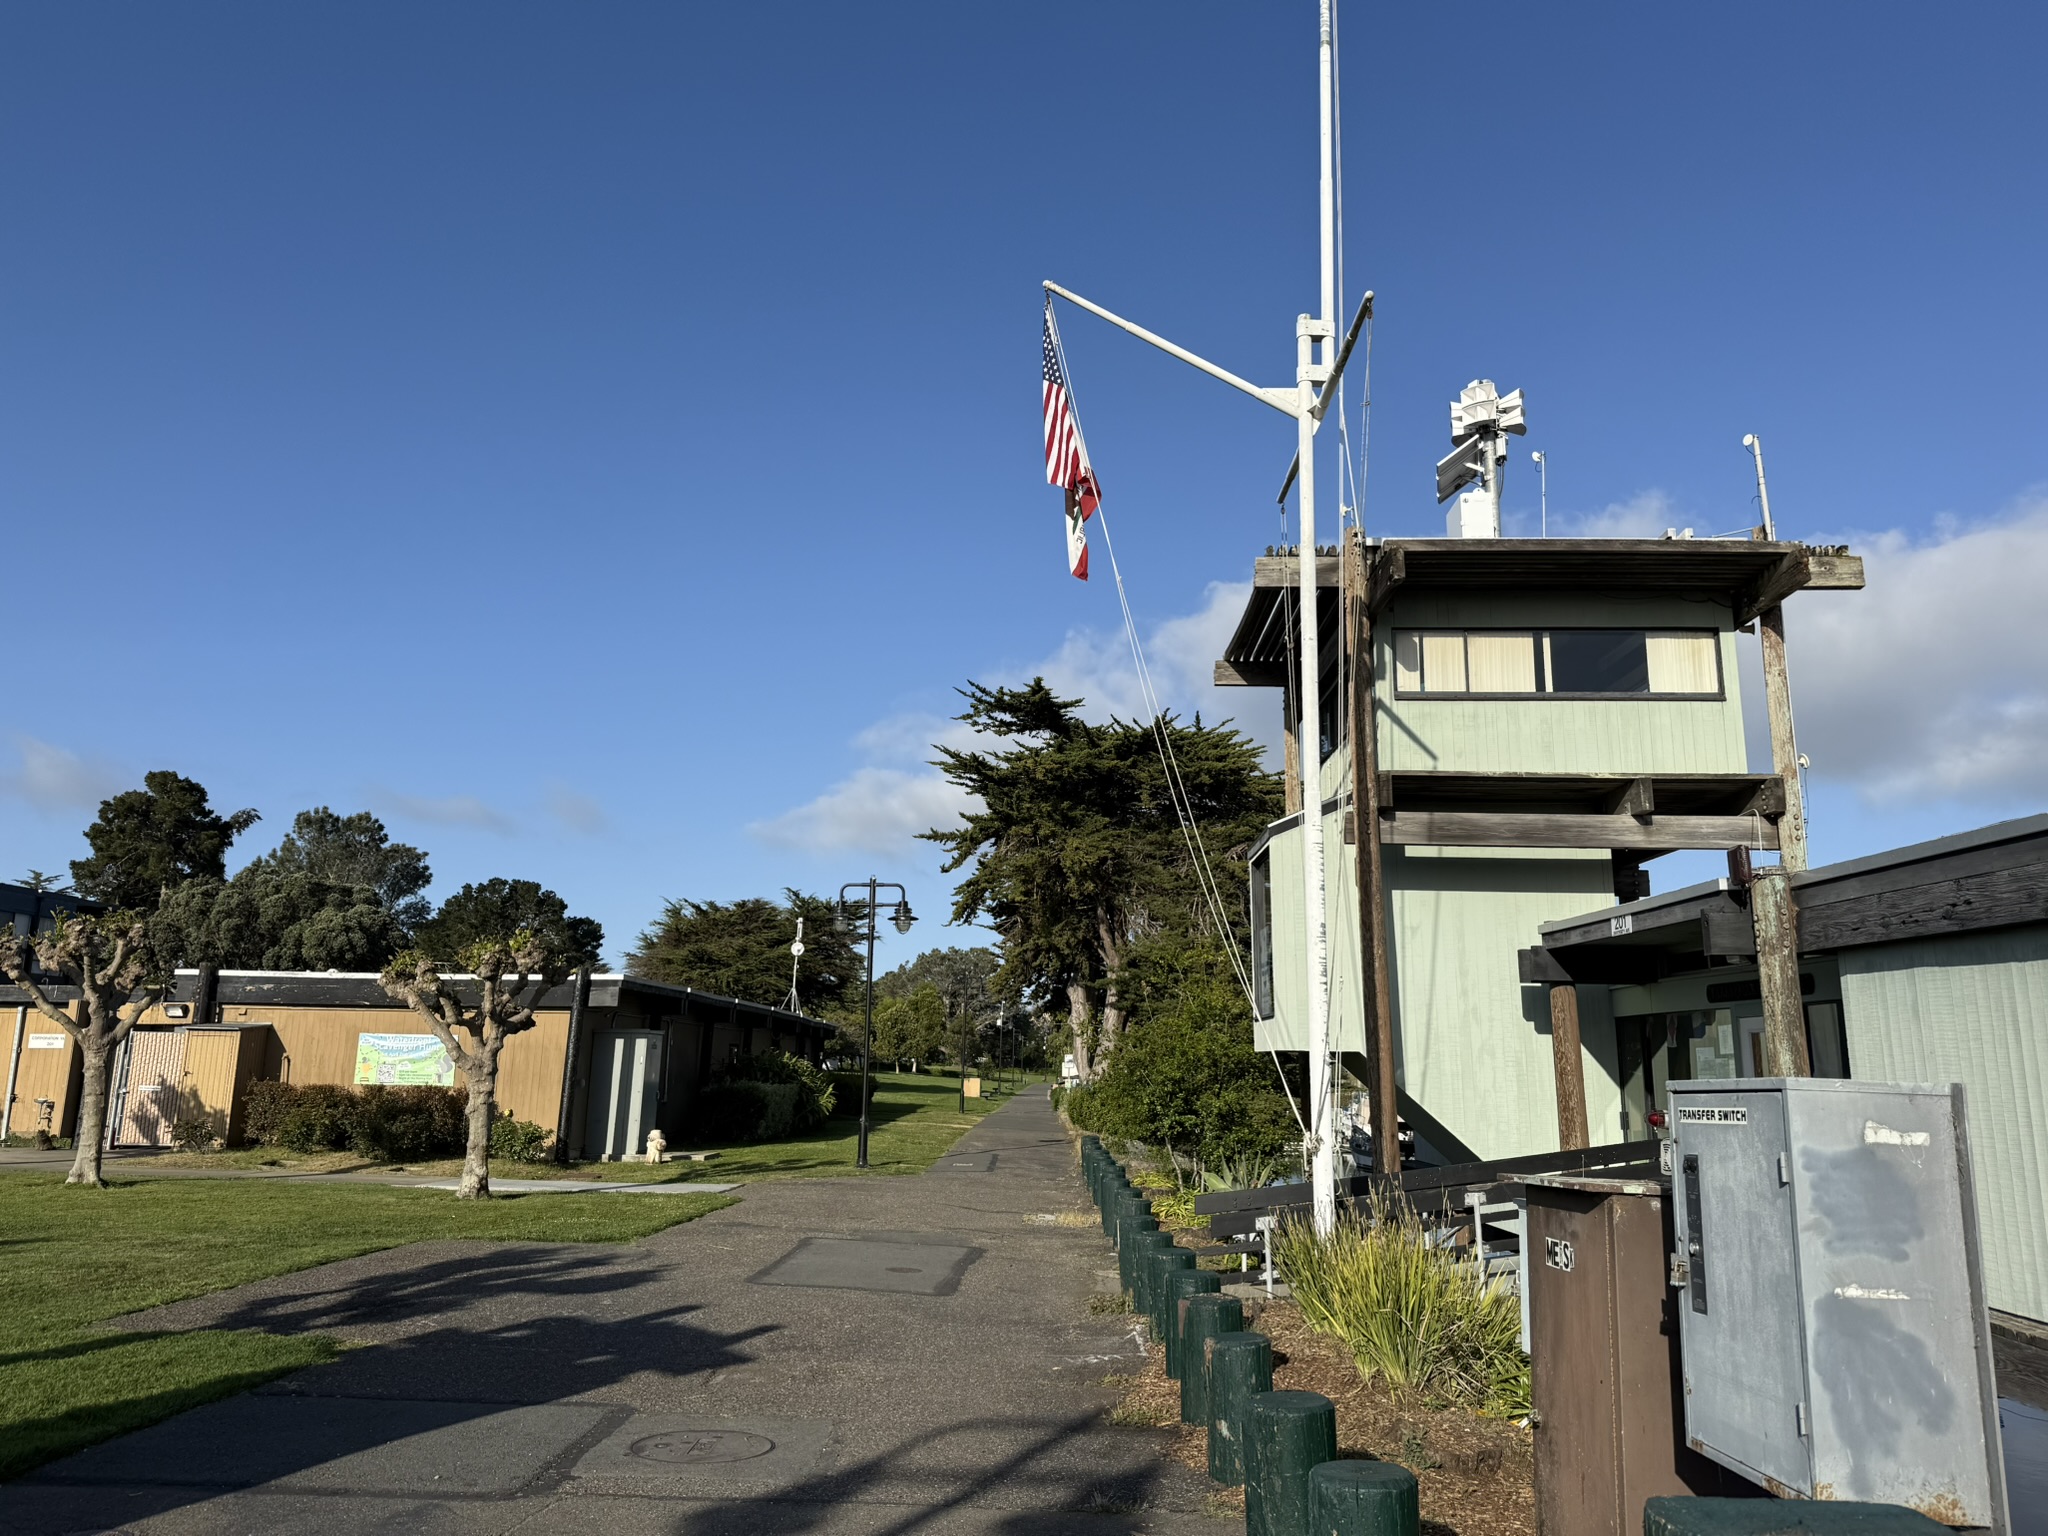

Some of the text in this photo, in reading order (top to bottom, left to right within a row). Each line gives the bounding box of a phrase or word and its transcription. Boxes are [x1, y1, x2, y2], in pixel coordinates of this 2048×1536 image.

[1615, 915, 1627, 930] 201
[386, 1035, 432, 1044] Waterfront
[374, 1043, 418, 1052] Scavenger
[1679, 1109, 1747, 1122] TRANSFER SWITCH
